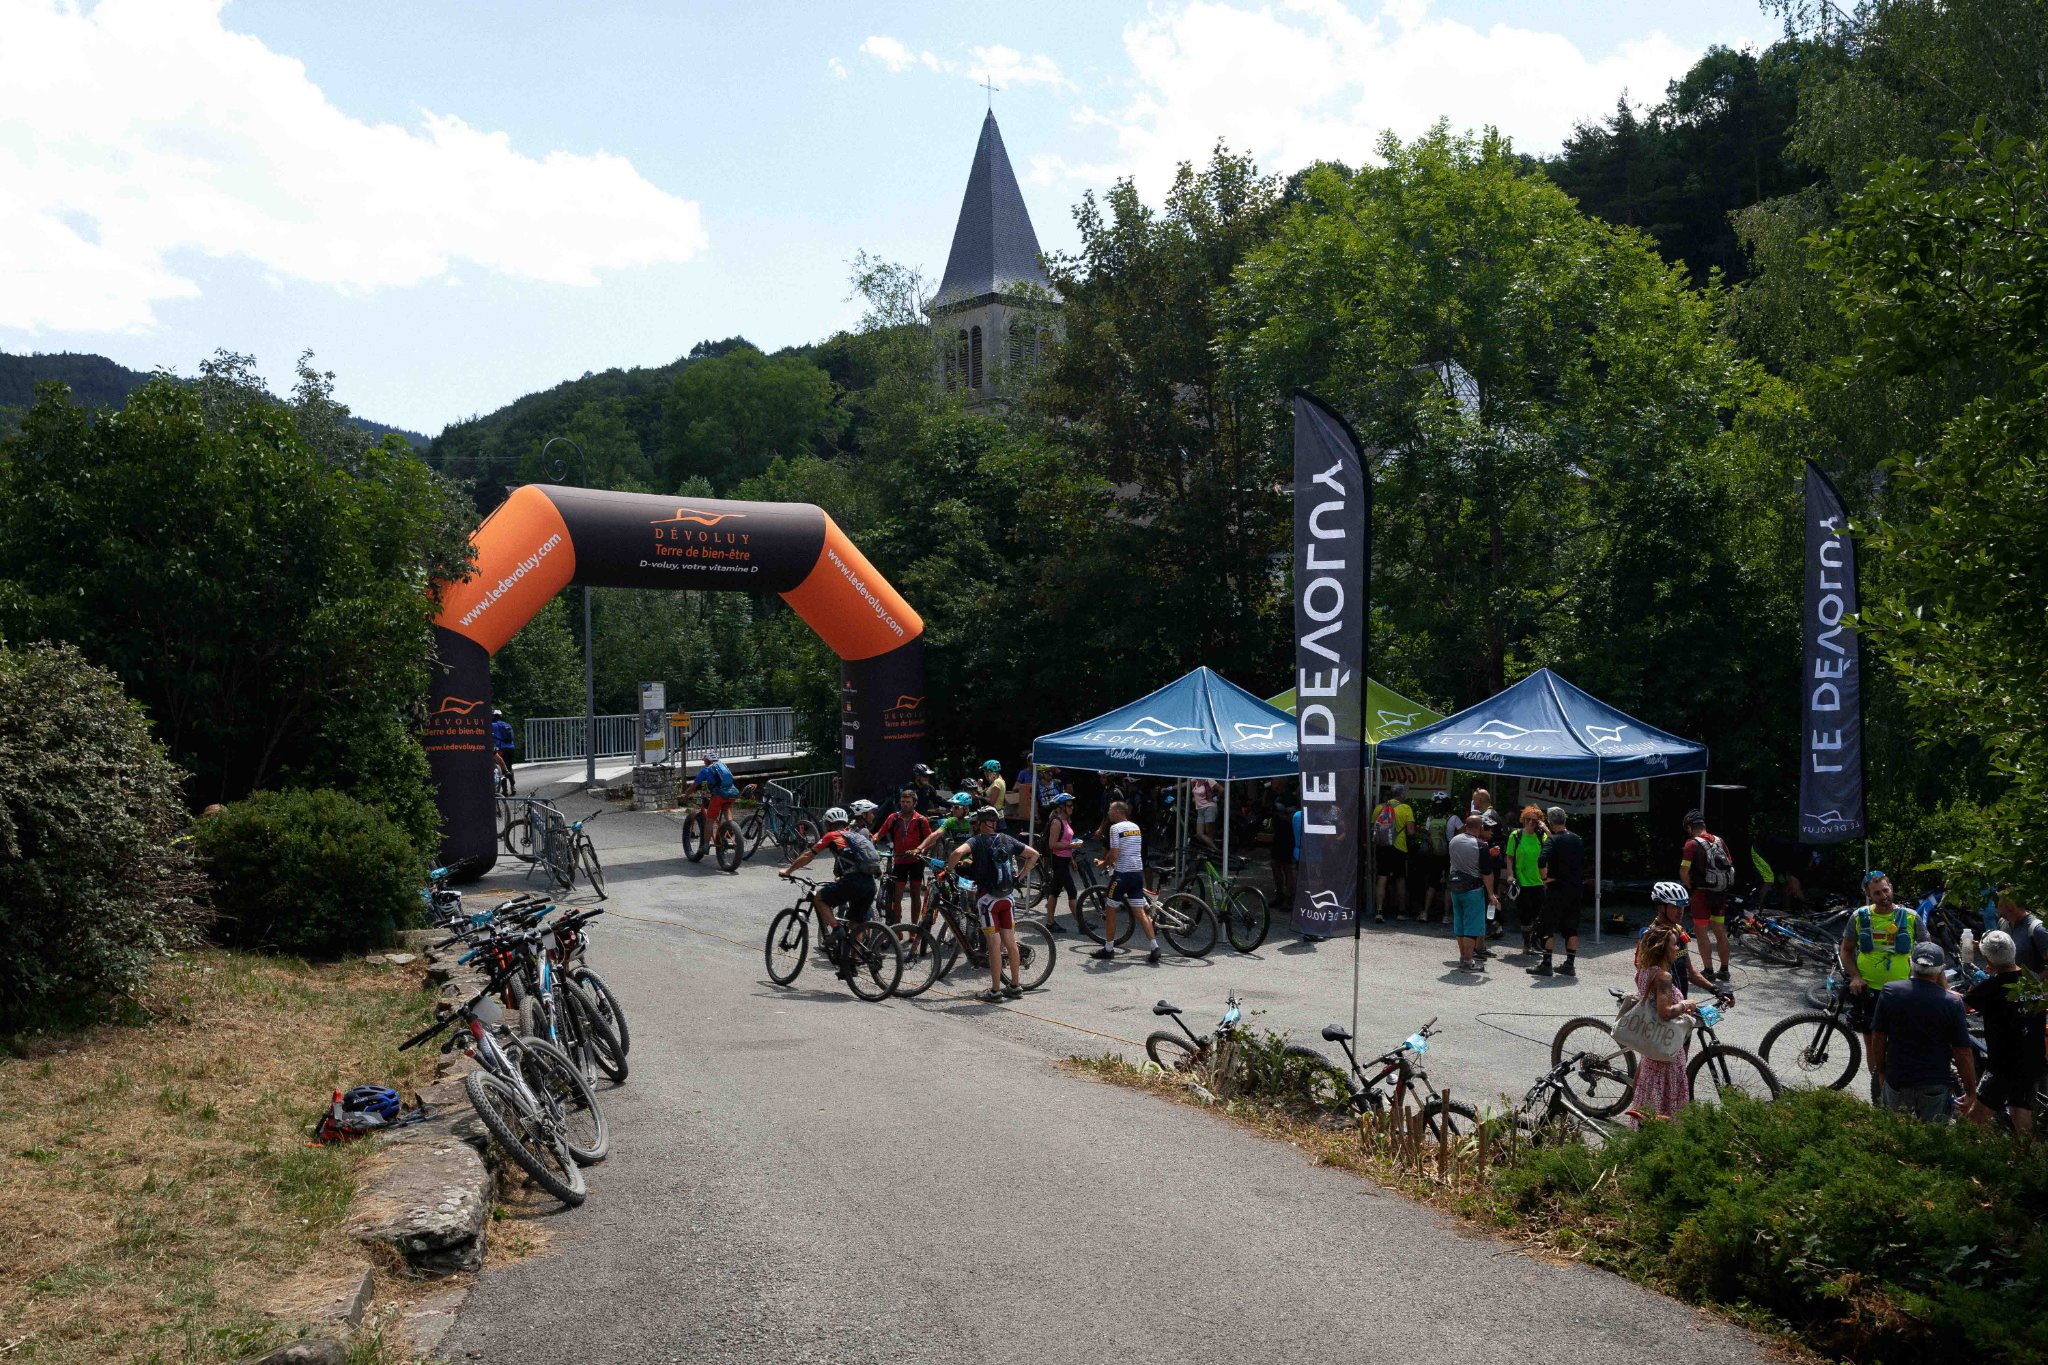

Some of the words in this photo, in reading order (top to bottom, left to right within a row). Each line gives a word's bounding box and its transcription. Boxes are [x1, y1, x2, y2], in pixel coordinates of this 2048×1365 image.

[655, 527, 750, 545] DÉVOLUY
[655, 543, 683, 556] Terre
[685, 546, 700, 558] de
[702, 546, 751, 561] bien-être
[639, 559, 680, 571] D-voluy,
[682, 562, 707, 571] votre
[709, 564, 750, 574] vitamine
[750, 565, 759, 573] D
[459, 532, 562, 627] www.ledevoluy.com
[827, 548, 905, 638] www.ledevoluy.com
[1082, 732, 1106, 741] LE
[1428, 735, 1453, 744] LE
